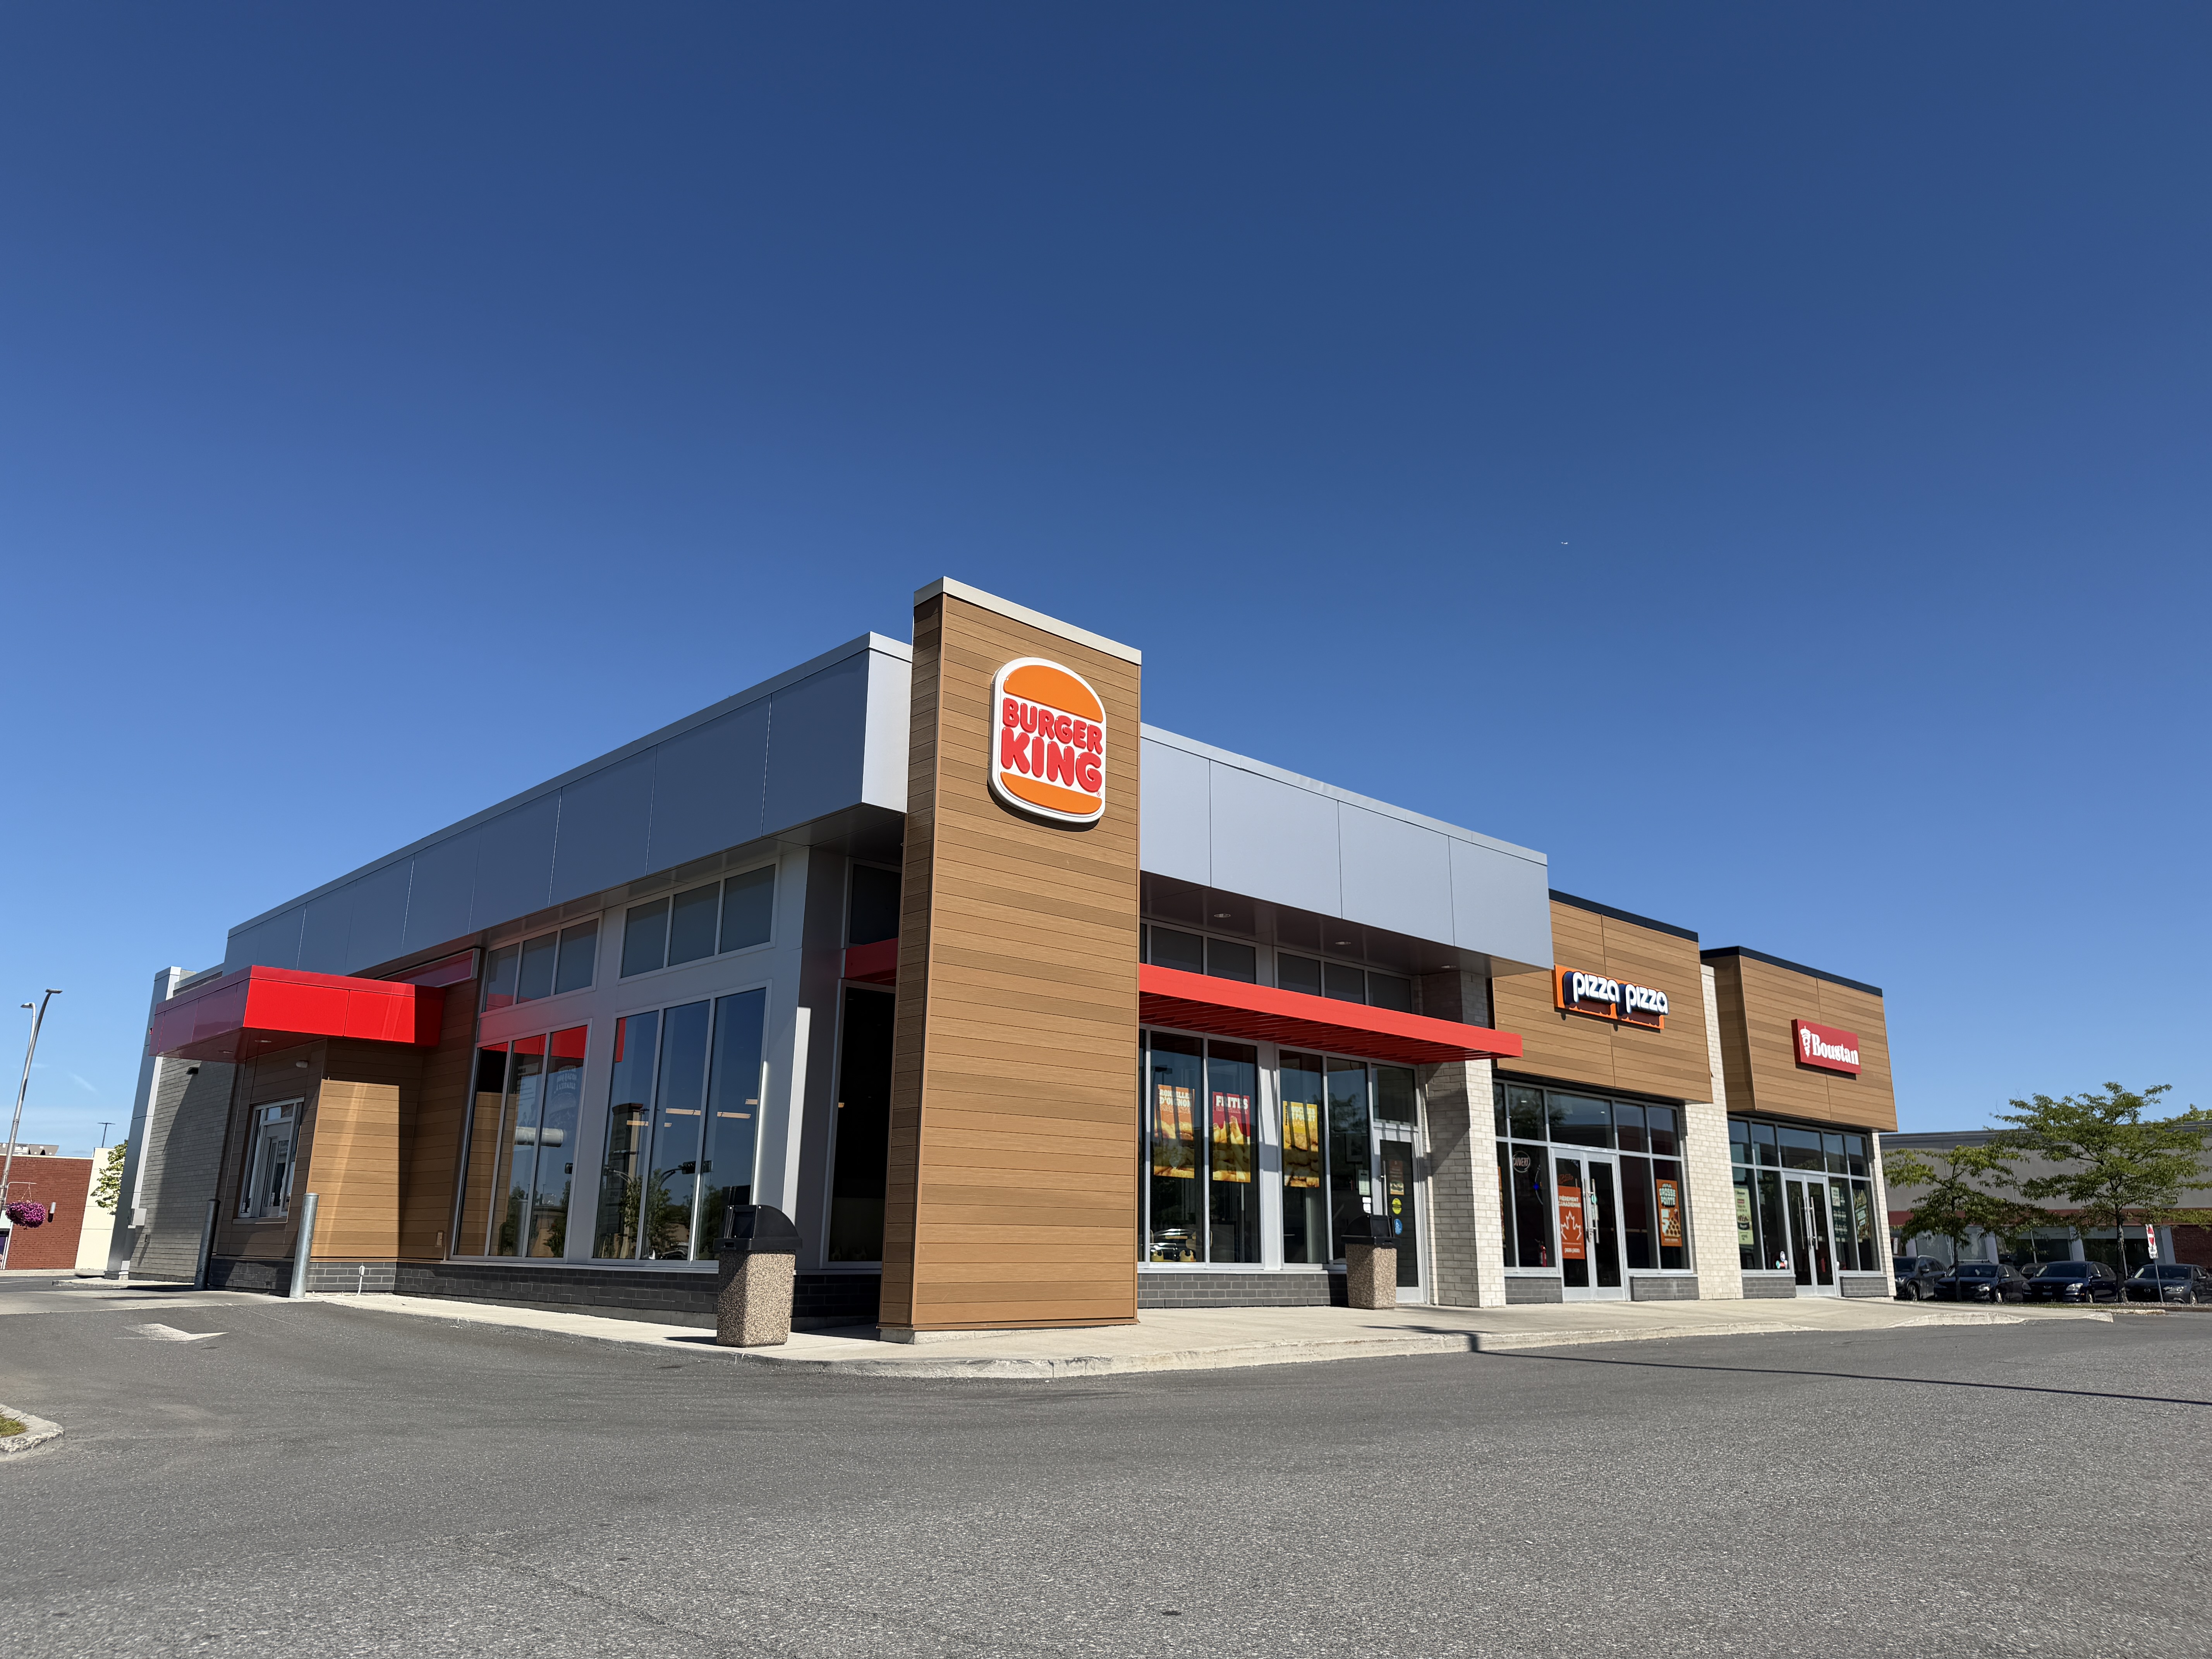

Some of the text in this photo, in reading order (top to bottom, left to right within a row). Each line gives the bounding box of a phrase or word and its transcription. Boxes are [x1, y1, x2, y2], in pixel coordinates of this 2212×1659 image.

[1003, 697, 1103, 754] BURGER
[1001, 727, 1102, 792] KING
[1573, 972, 1669, 1015] pizza pizza
[1812, 1033, 1859, 1065] Boustan
